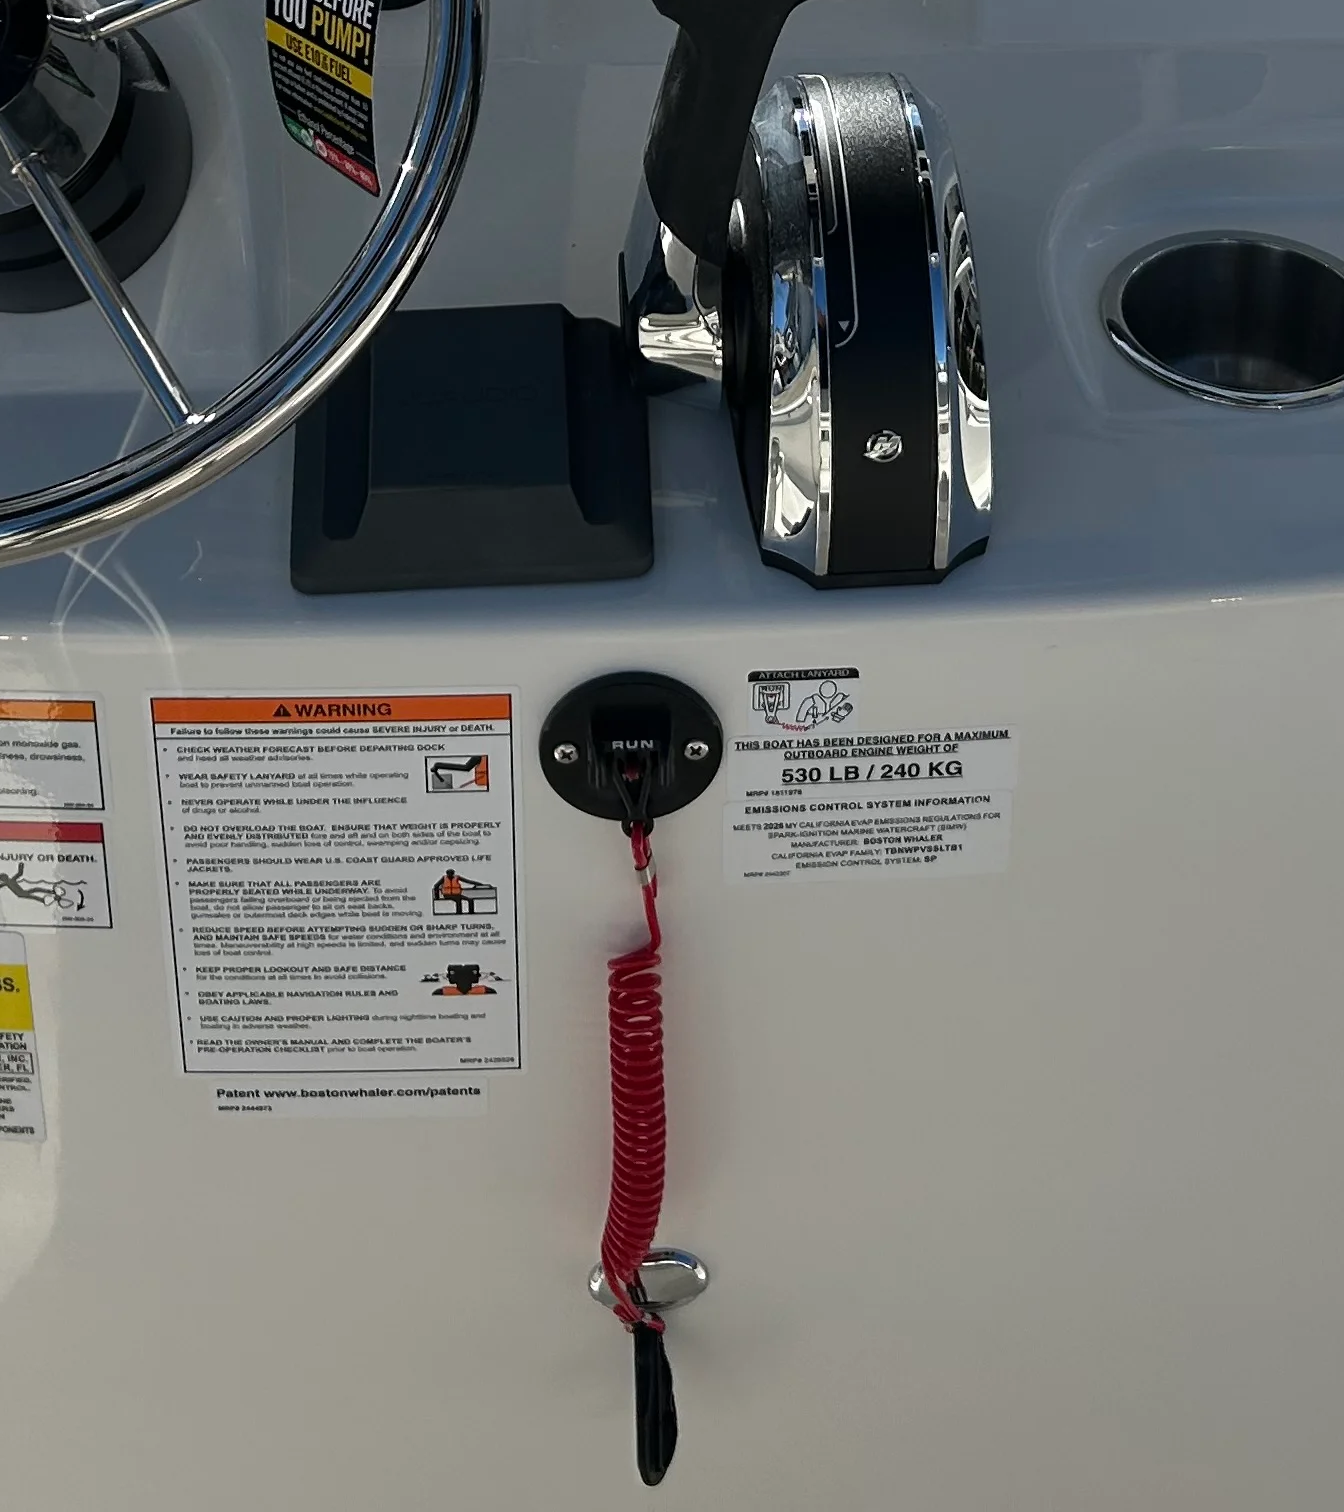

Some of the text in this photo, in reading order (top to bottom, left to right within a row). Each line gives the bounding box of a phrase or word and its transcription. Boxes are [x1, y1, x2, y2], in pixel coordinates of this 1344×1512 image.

[311, 4, 370, 65] PUMP!
[285, 32, 303, 56] USE
[305, 43, 321, 66] E10
[330, 59, 352, 85] FUEL
[759, 669, 849, 679] ATTACH LANYARD
[295, 703, 392, 717] WARNING
[612, 739, 655, 751] RUN
[735, 730, 1009, 750] THIS BOAT HAS BEEN DESIGNED FOR MAXIMUM
[784, 749, 848, 759] OUTBOARD
[852, 746, 893, 757] ENGINE
[896, 744, 941, 755] WEIGHT
[782, 761, 962, 783] 530 LB 240 KG
[745, 795, 990, 814] EMISSIONS CONTROL SYSTEM INFORMATION
[864, 834, 943, 844] BOSTON WHALER
[57, 854, 97, 863] DEATH.
[217, 1087, 481, 1099] Patent www.bostonwhaler.com/patents
